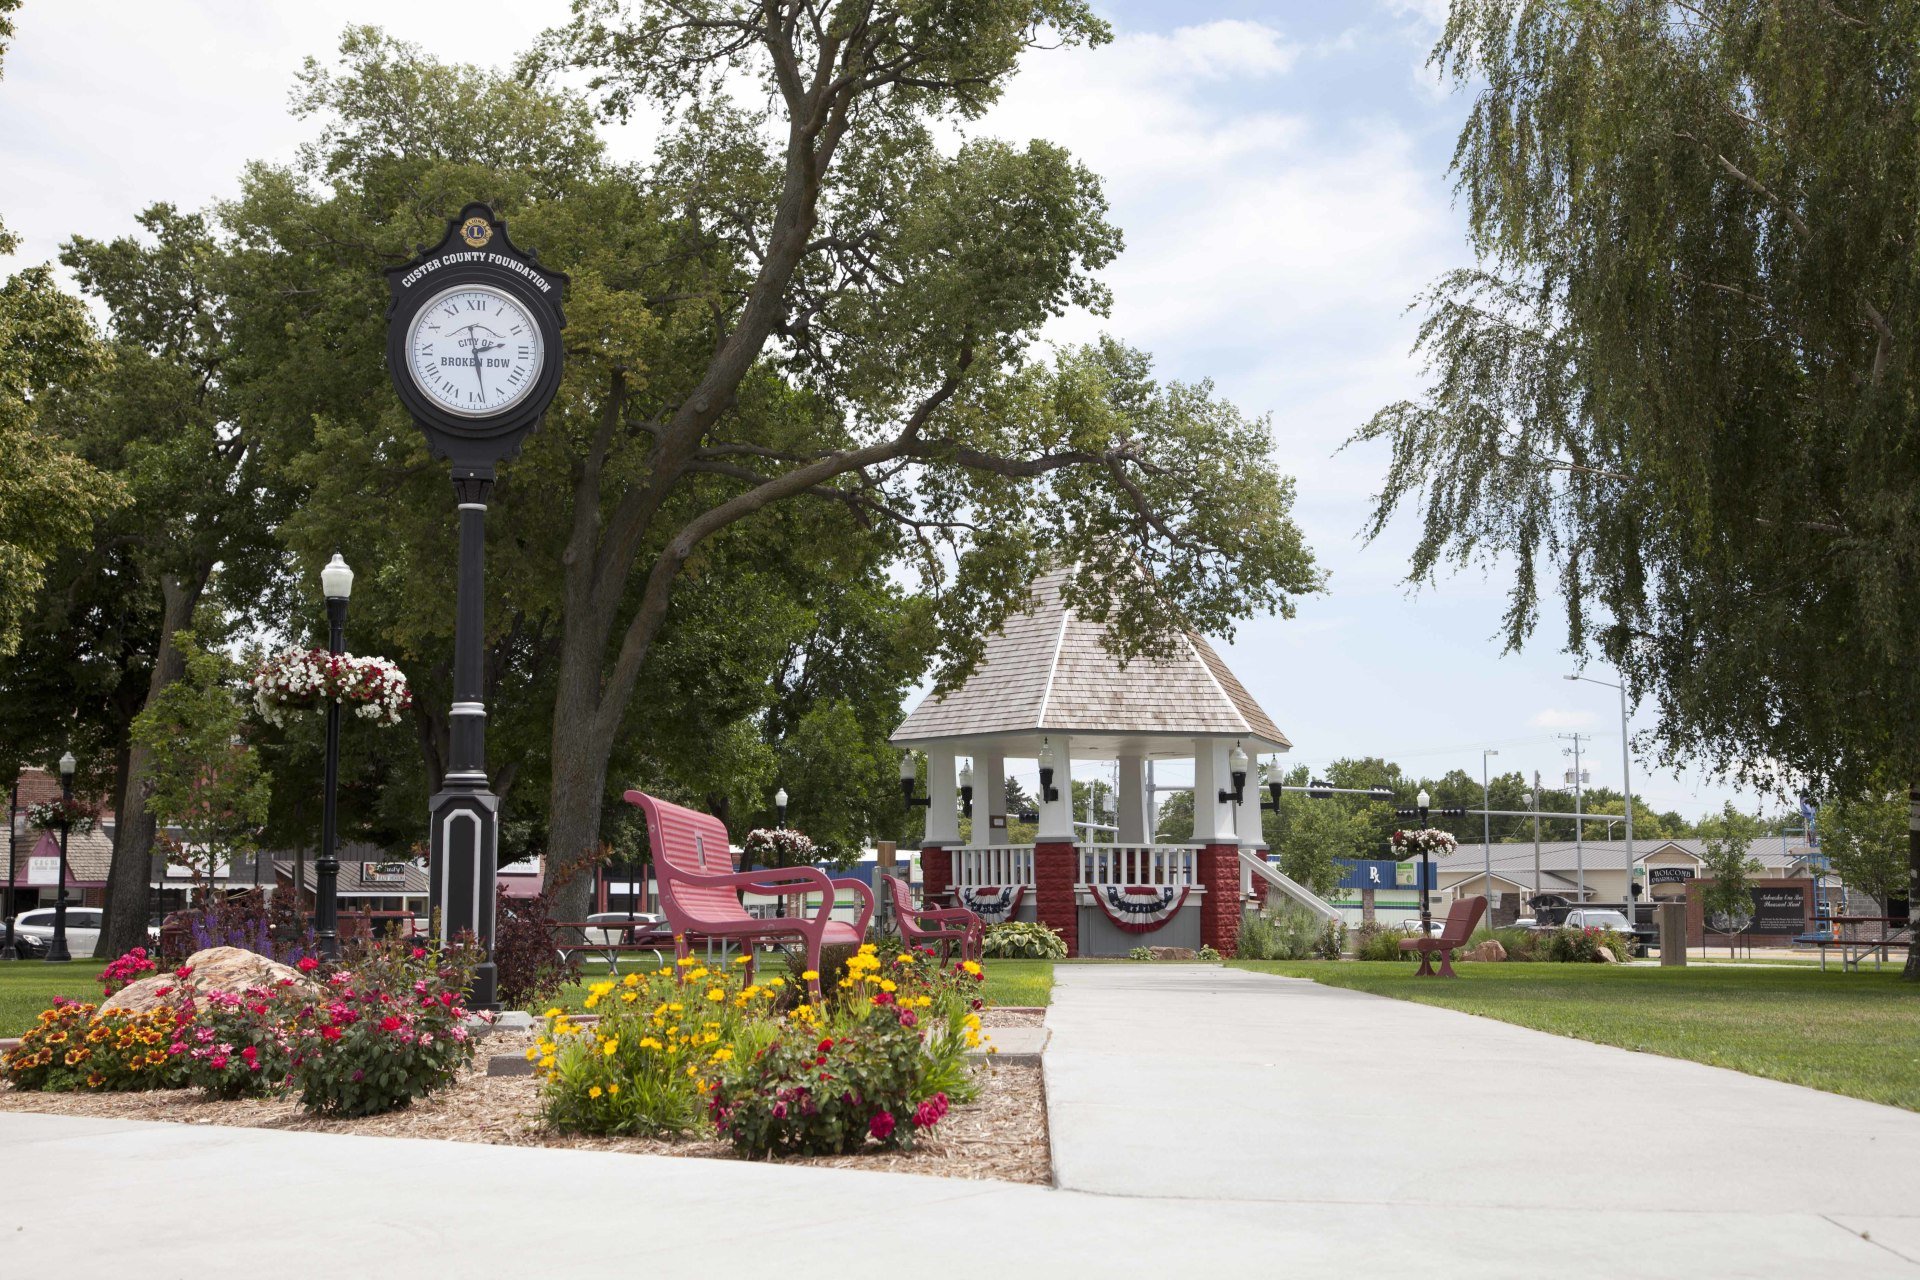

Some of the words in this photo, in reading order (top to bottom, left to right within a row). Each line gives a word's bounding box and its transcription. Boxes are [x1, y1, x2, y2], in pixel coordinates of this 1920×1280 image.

[473, 226, 482, 237] L
[402, 259, 442, 288] CUSTER
[443, 251, 486, 266] COUNTY
[488, 253, 551, 293] FOUNDATION
[444, 304, 459, 318] XI
[466, 300, 486, 311] XII
[458, 338, 479, 348] CITY
[482, 339, 494, 348] OF
[441, 356, 483, 367] BROKEN
[486, 358, 510, 368] BOW
